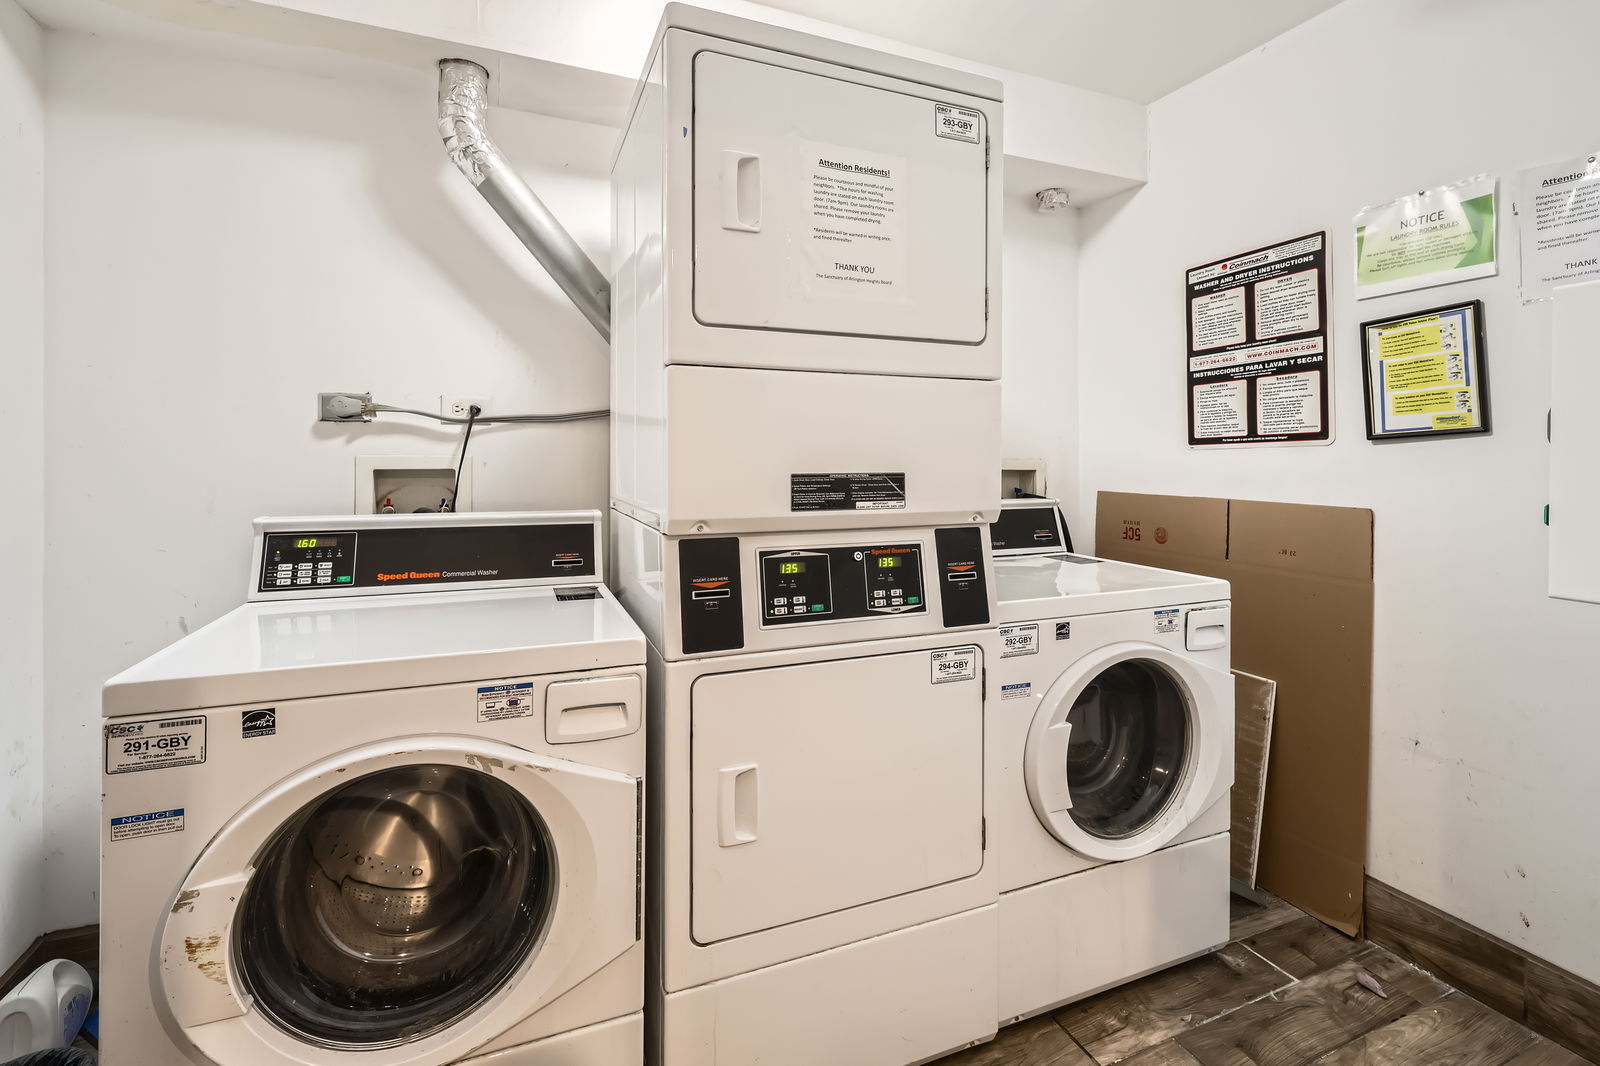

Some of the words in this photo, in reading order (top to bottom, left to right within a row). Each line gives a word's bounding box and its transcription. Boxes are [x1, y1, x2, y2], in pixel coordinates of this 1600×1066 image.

[943, 118, 973, 130] 293-GBY
[819, 158, 853, 170] Attention
[855, 164, 890, 177] Residents!
[1400, 210, 1445, 229] NOTICE
[834, 262, 859, 272] THANK
[860, 266, 875, 274] YOU
[1229, 254, 1269, 270] Coinmach
[1565, 258, 1598, 270] THANK
[1194, 278, 1219, 290] WASHER
[1220, 275, 1234, 284] AND
[1235, 269, 1258, 280] DRYER
[1258, 255, 1315, 274] INSTRUCTIONS
[1247, 344, 1317, 359] WWW.COINMACH.COM
[1194, 365, 1244, 379] INSTRUCCIONES
[1245, 364, 1264, 372] PARA
[1265, 360, 1288, 369] LAVAR
[1297, 355, 1323, 364] SECAR
[782, 563, 798, 574] 135
[879, 558, 894, 567] 135
[377, 572, 408, 582] Speed
[410, 571, 440, 579] Queen
[442, 569, 477, 578] Commercial
[477, 568, 499, 576] Washer
[1005, 636, 1033, 646] 292-GBY
[939, 661, 969, 671] 294-GBY
[110, 726, 136, 734] CSC
[123, 736, 192, 753] 291-GBY
[122, 811, 175, 823] NOTICE
